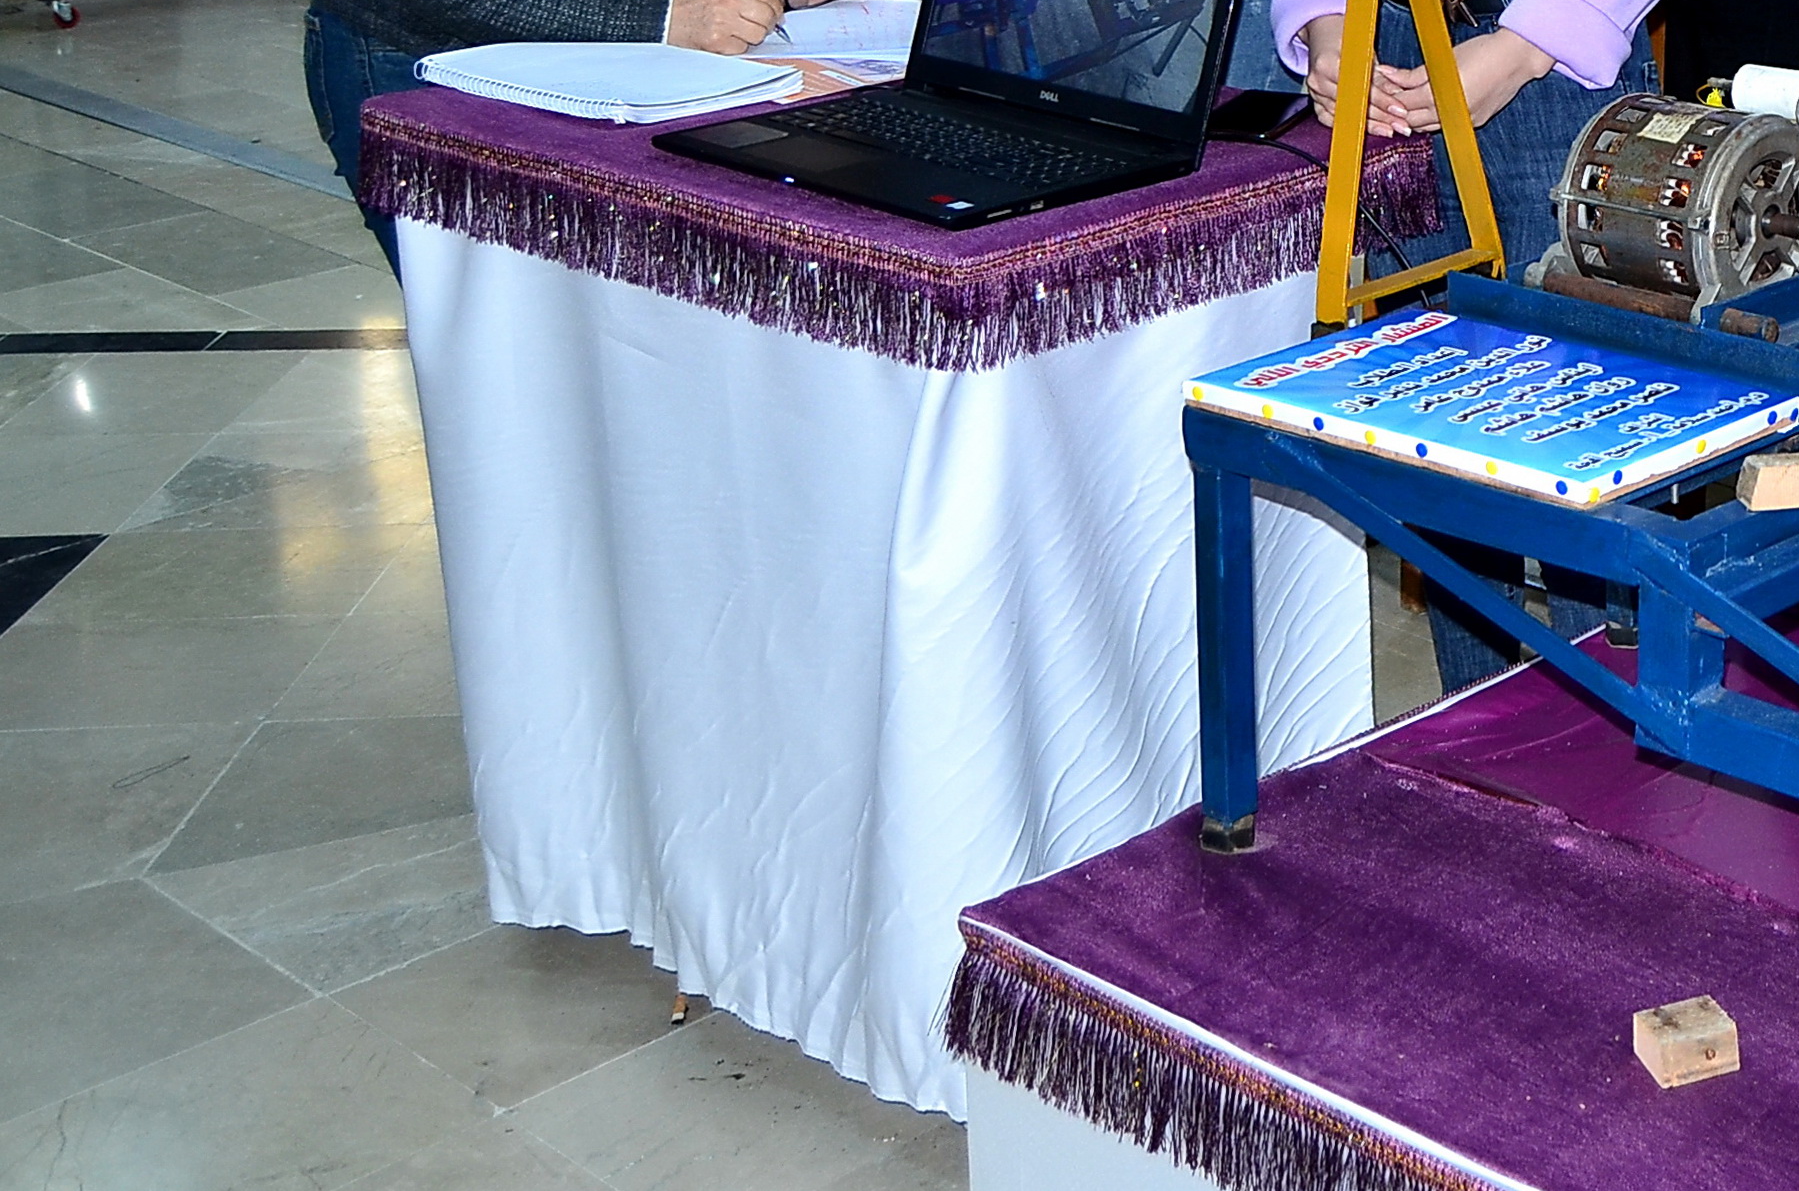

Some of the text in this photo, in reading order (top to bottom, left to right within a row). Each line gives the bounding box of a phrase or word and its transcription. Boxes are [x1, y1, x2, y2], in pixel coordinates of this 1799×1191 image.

[1039, 89, 1060, 103] DELL
[1380, 313, 1451, 344] المنشار
[1521, 335, 1549, 352] نور
[1299, 338, 1380, 370] الترددي
[1350, 362, 1415, 388] الطلاب
[1415, 361, 1547, 413] علاء ممدوح عامر
[1426, 365, 1470, 384] محمد
[1483, 377, 1634, 434] روان هاشم هاشم
[1527, 383, 1678, 443] ناصر محمد يوسف
